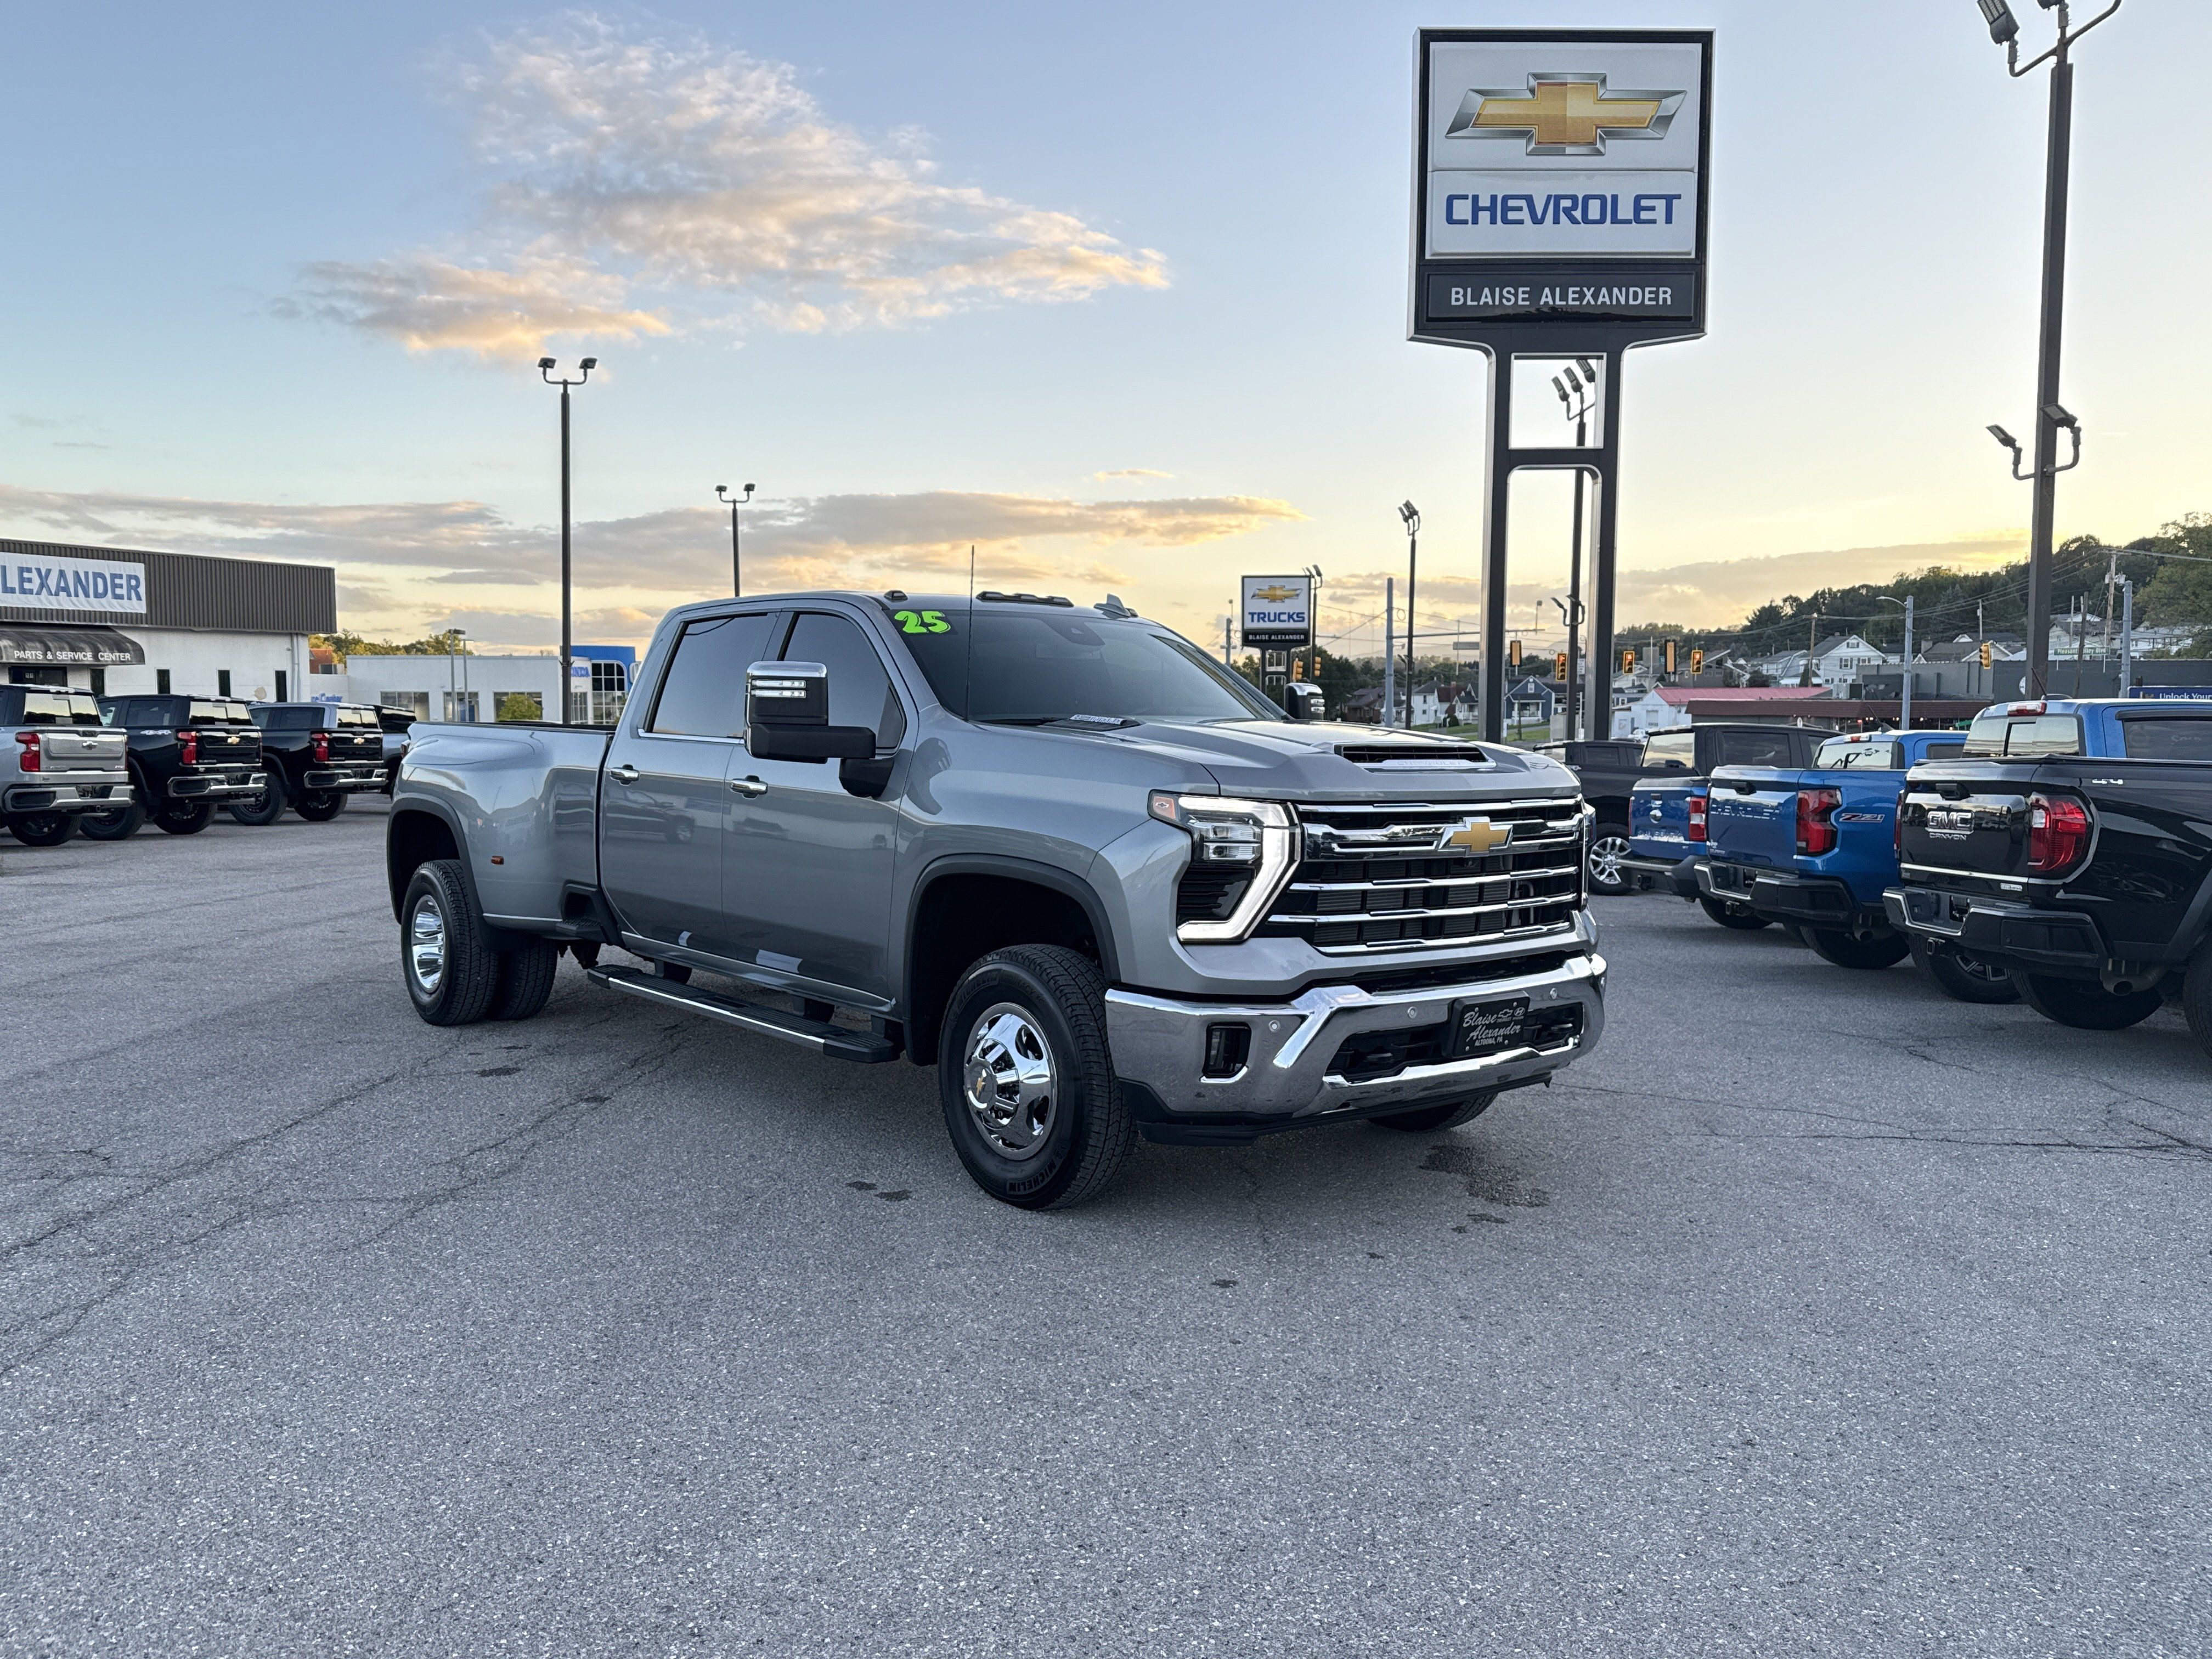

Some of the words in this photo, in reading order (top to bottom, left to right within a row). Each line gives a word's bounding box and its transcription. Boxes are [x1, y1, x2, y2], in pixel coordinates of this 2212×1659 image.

[1446, 194, 1682, 225] CHEVROLET
[1451, 286, 1530, 306] BLAISE
[1539, 286, 1672, 306] ALEXANDER
[0, 565, 143, 601] LEXANDER
[894, 611, 951, 633] 25
[1248, 612, 1306, 623] TRUCKS
[14, 650, 43, 659] PARTS
[47, 651, 53, 660] &
[56, 651, 93, 661] SERVICE
[98, 652, 131, 662] CENTER
[1927, 811, 1974, 831] GMC
[1929, 833, 1967, 841] CANYON
[1463, 1011, 1497, 1027] Blaise
[1466, 1022, 1521, 1042] Alexander
[1008, 1159, 1058, 1192] MICHELIN
